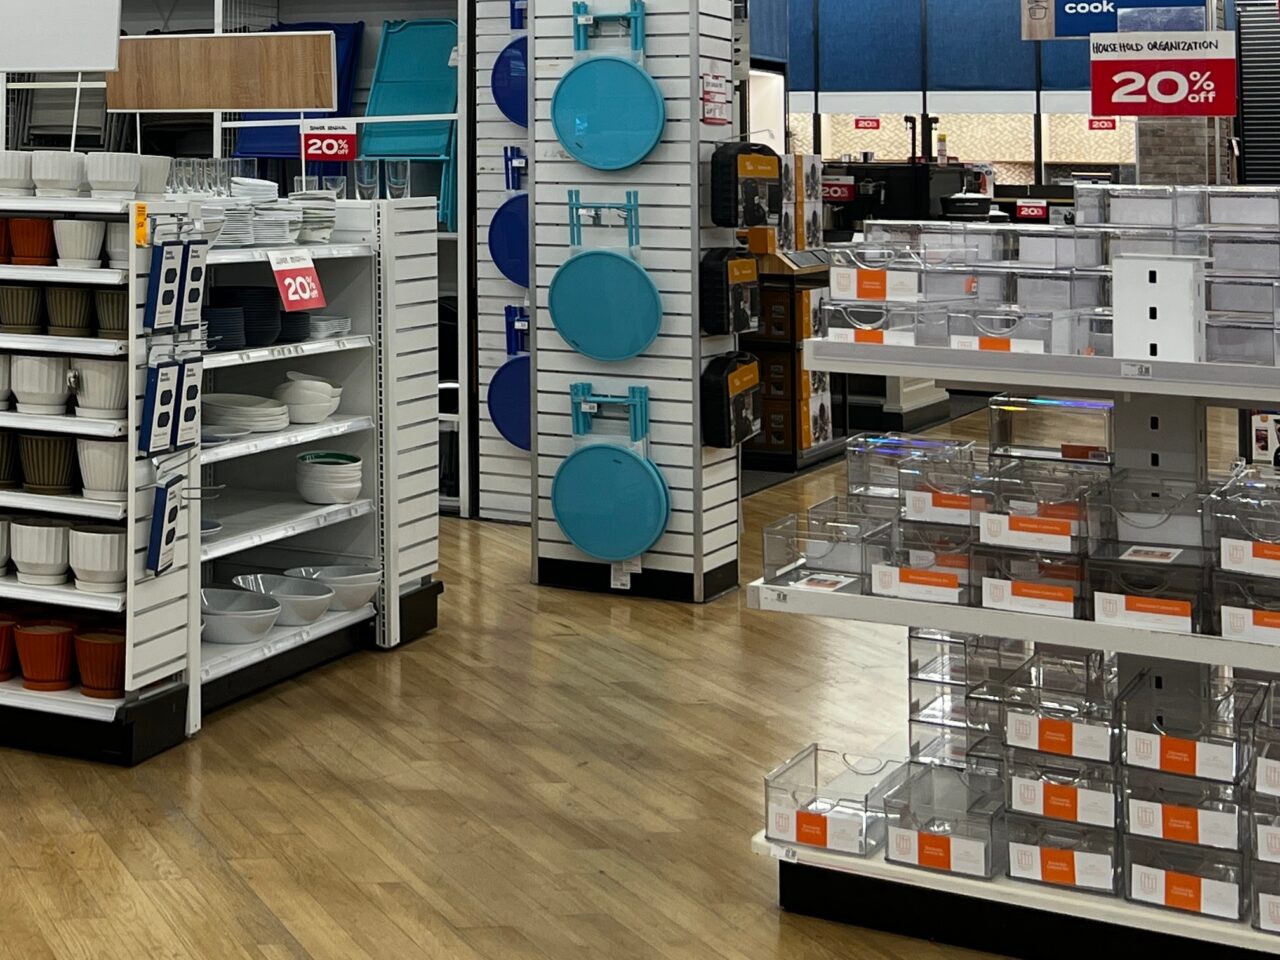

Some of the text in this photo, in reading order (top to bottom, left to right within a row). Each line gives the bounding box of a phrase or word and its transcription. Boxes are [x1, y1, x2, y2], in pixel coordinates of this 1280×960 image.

[1065, 0, 1114, 14] cook
[1093, 40, 1218, 53] HOUSEHOLD ORGANIZATION
[1111, 71, 1214, 103] 20%
[1188, 92, 1215, 102] off
[308, 139, 348, 154] 20%
[284, 276, 316, 300] 20%
